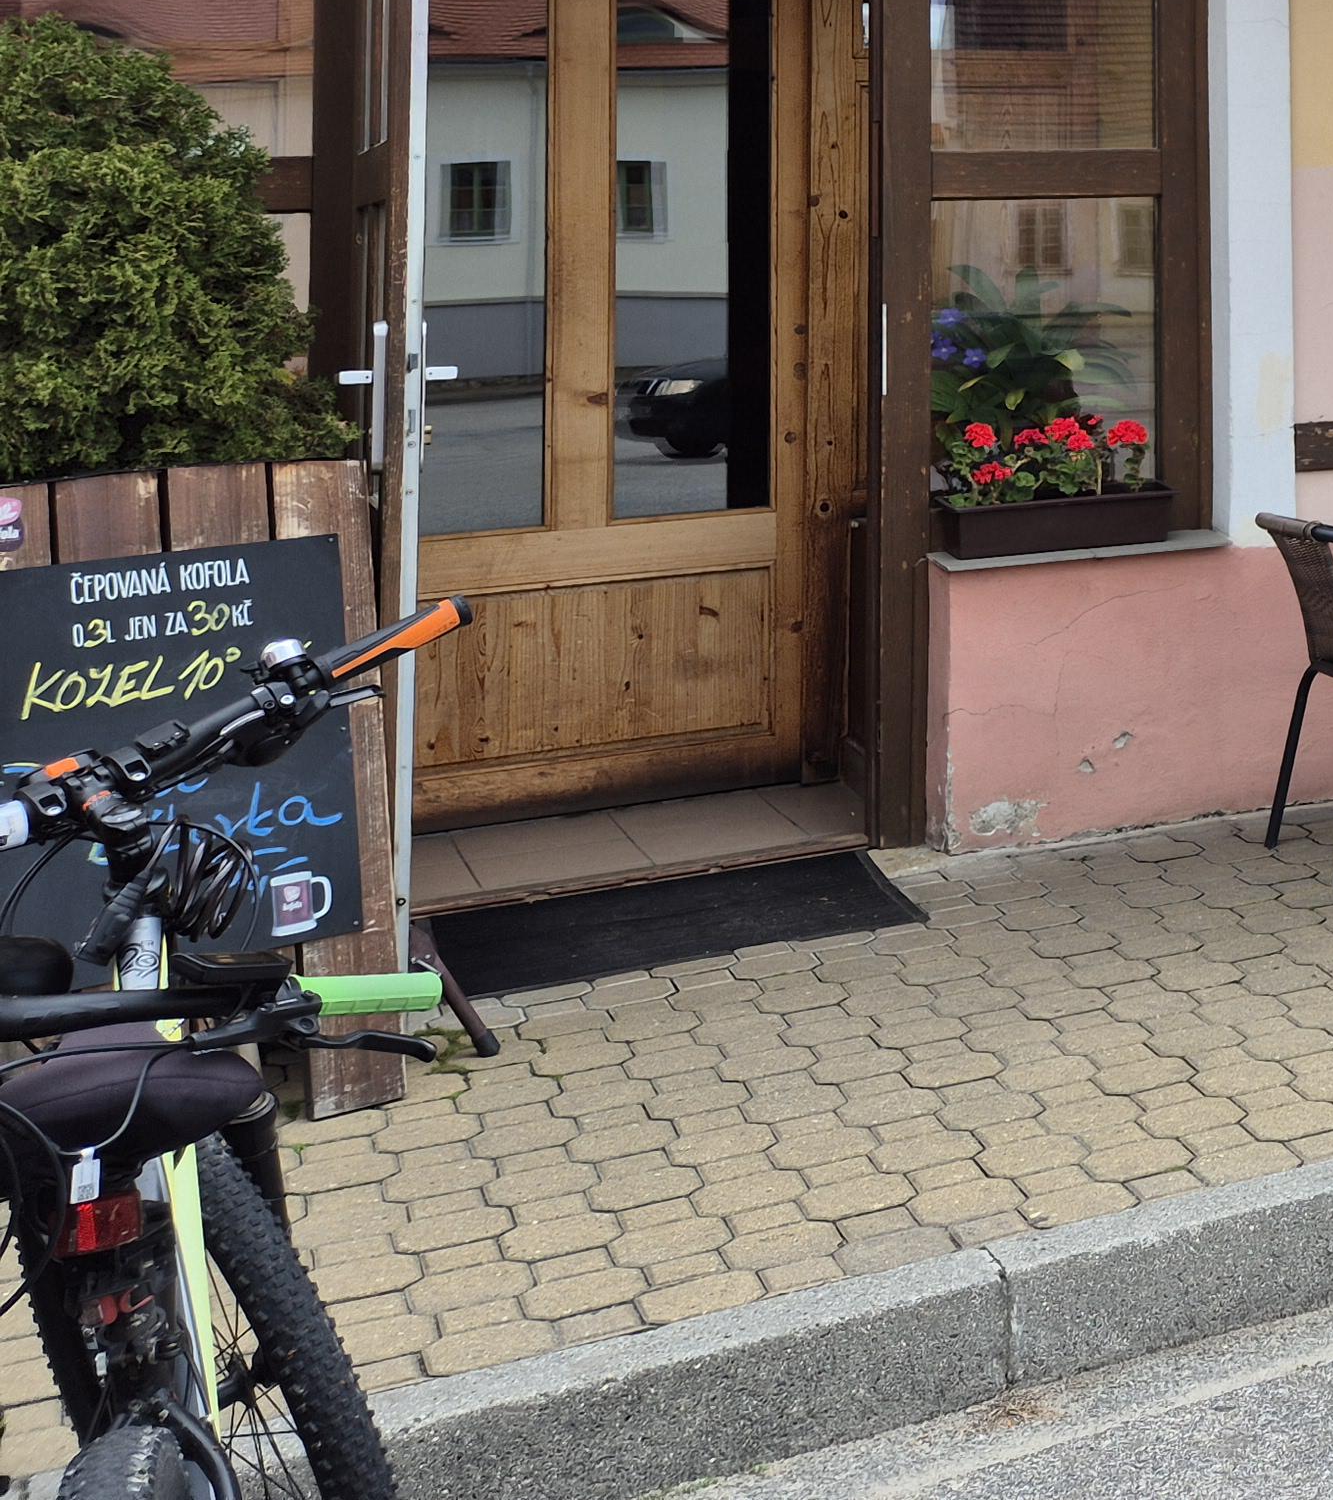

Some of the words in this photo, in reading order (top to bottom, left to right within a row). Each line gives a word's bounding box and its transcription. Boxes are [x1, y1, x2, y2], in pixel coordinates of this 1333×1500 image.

[69, 561, 173, 605] ČEPOVANÁ
[178, 558, 251, 592] KOFOLA
[123, 614, 157, 641] JEN
[164, 610, 189, 636] ZA
[186, 599, 232, 637] 30
[231, 598, 255, 628] KČ
[18, 651, 177, 721] KOZEL
